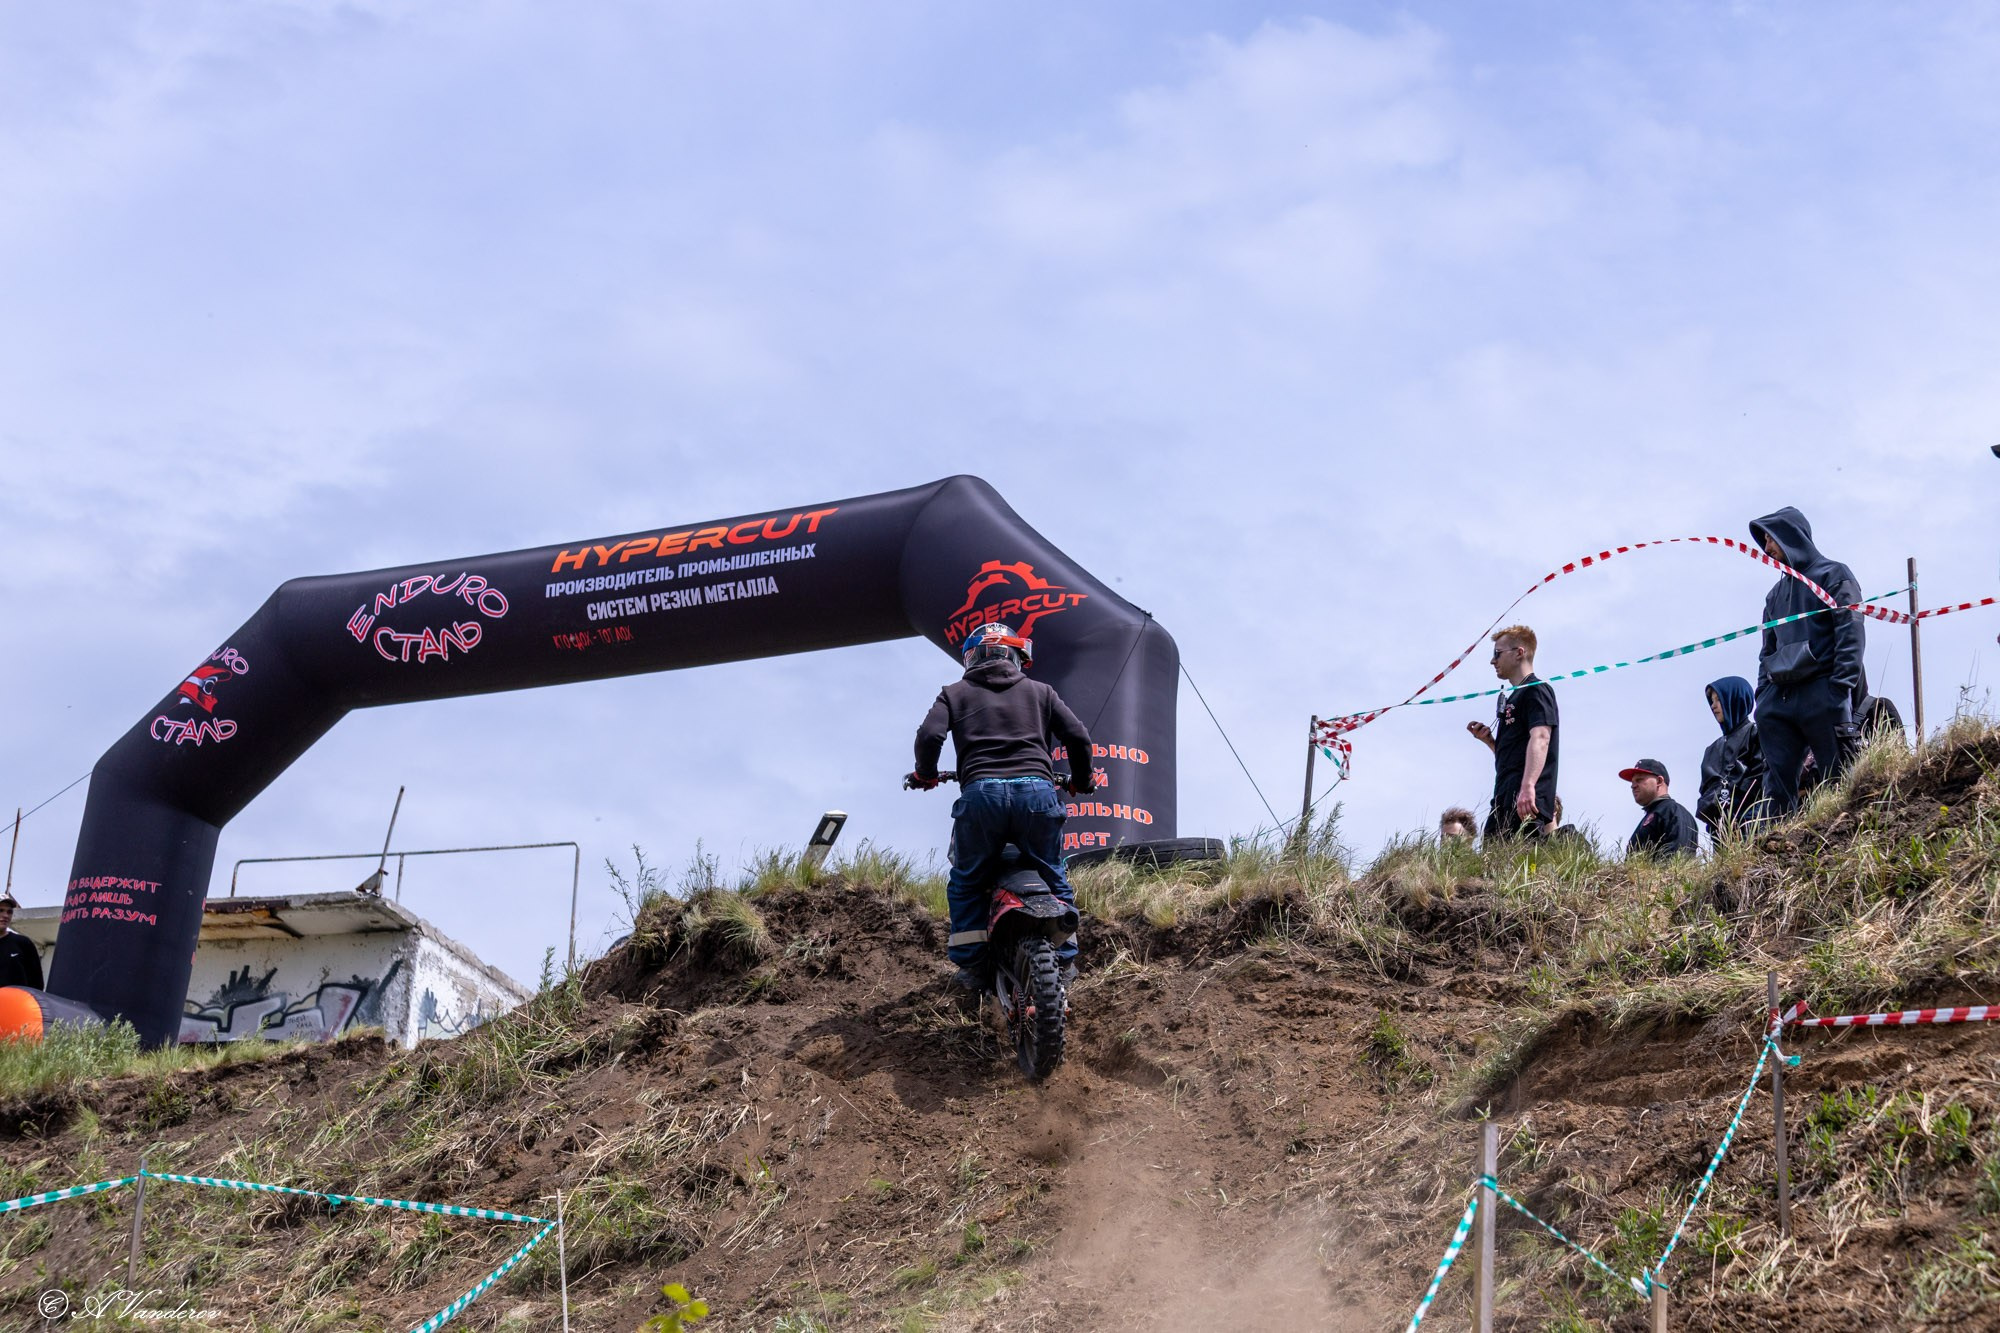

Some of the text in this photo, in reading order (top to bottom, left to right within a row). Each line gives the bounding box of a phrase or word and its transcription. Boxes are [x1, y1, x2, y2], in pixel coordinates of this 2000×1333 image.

[551, 507, 839, 574] HYPERCUT
[545, 543, 816, 598] ПРОИЗВОДИТЕЛЬ ПРОМЫШЛЕННЫХ
[347, 571, 509, 643] ENDURO
[586, 575, 780, 621] СИСТЕМ РЕЗКИ МЕТАЛЛА
[943, 593, 1089, 646] HYPERCUT
[1065, 802, 1153, 825] ально
[1063, 831, 1111, 850] дет
[79, 876, 162, 893] ВЫДЕРЖИТ
[88, 892, 134, 905] ЛИШЬ
[91, 907, 157, 926] РАЗУМ
